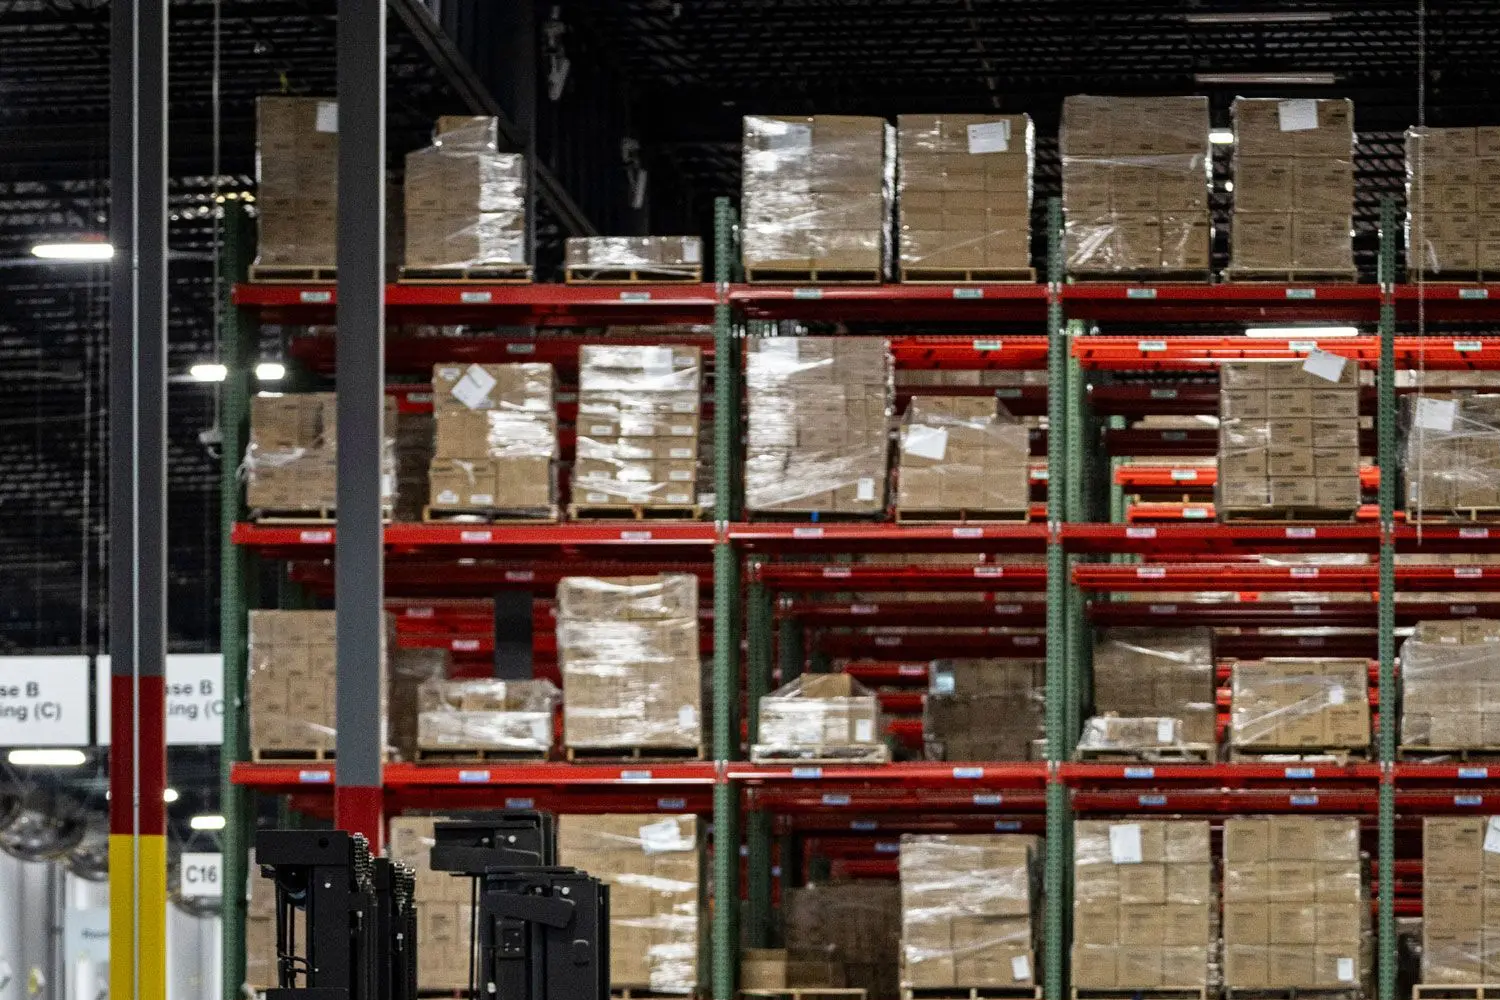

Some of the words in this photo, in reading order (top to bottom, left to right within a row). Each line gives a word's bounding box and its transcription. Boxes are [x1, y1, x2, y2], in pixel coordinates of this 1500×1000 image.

[26, 681, 40, 697] B
[200, 679, 212, 696] B
[35, 701, 62, 721] (C)
[186, 865, 218, 883] C16
